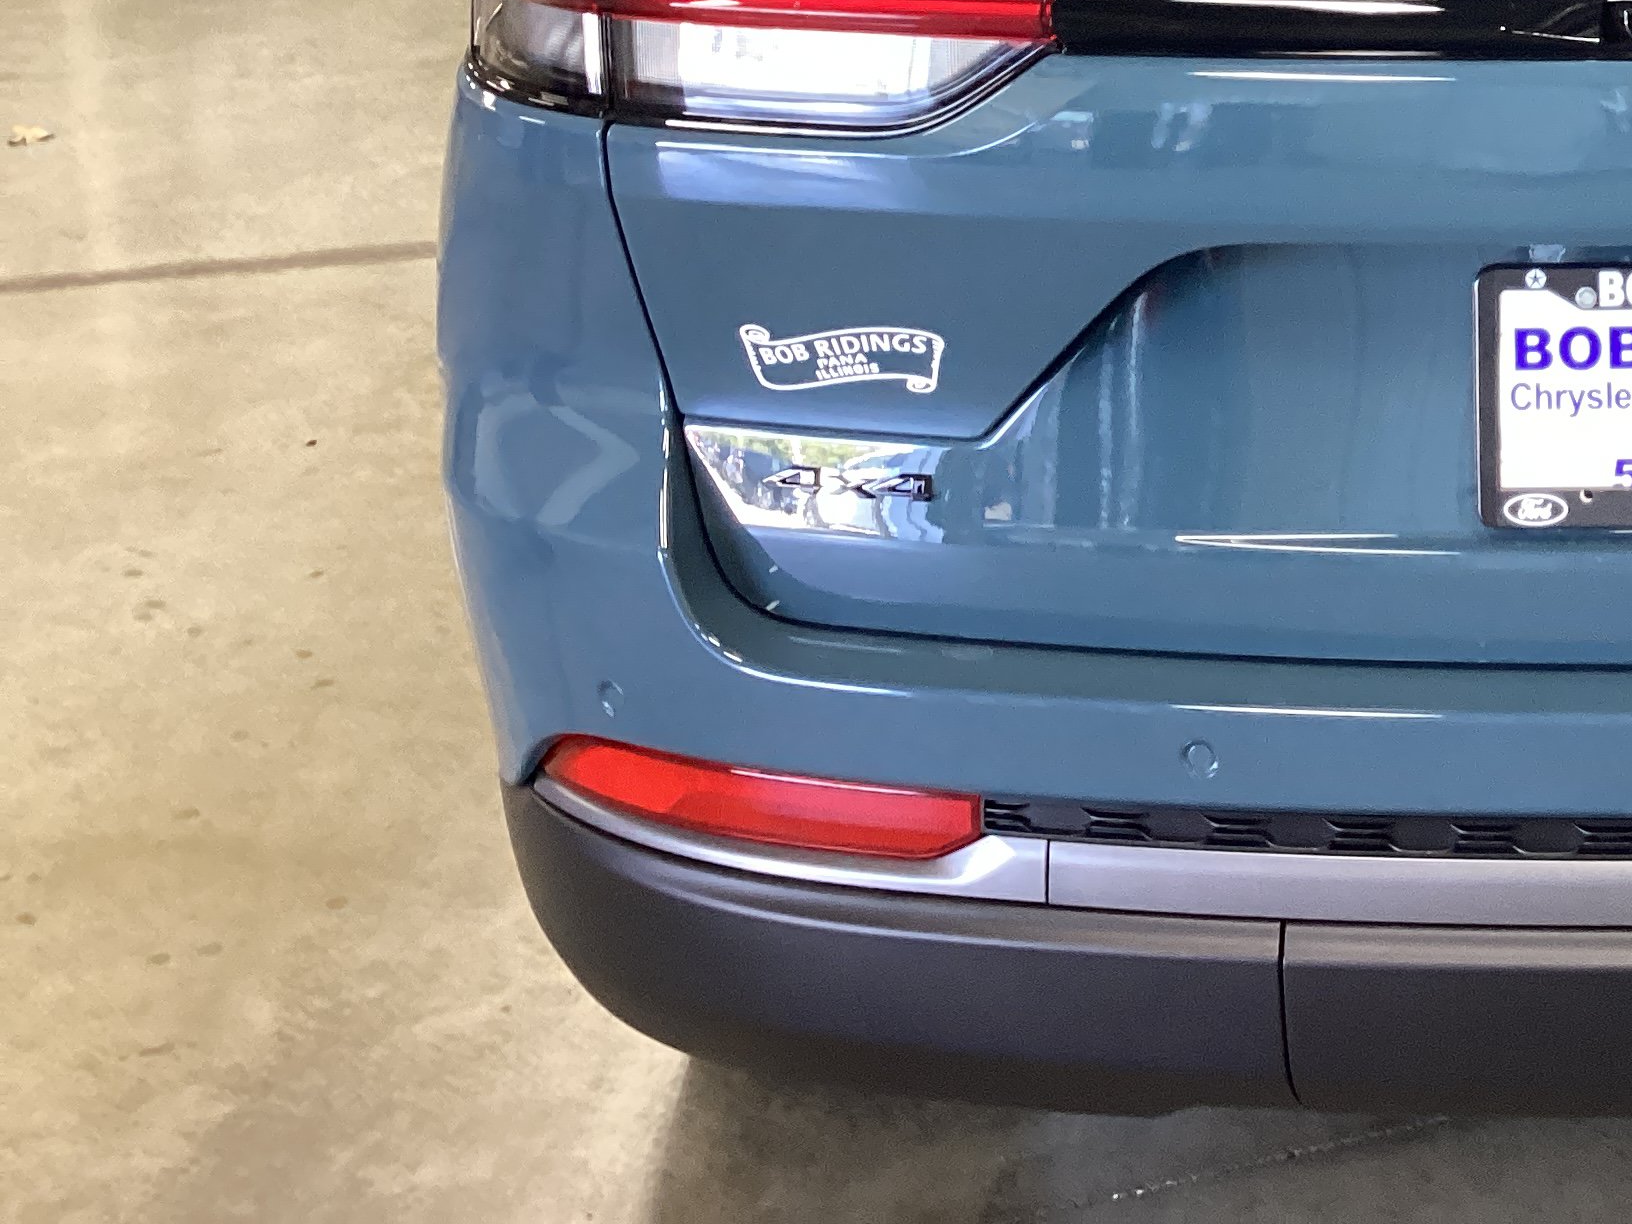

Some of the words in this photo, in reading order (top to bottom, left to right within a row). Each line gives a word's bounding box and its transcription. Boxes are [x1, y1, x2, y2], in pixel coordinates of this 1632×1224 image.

[758, 343, 810, 366] BOB
[814, 334, 927, 358] RIDINGS
[817, 352, 868, 369] PANA
[816, 363, 880, 380] ILLINOIS
